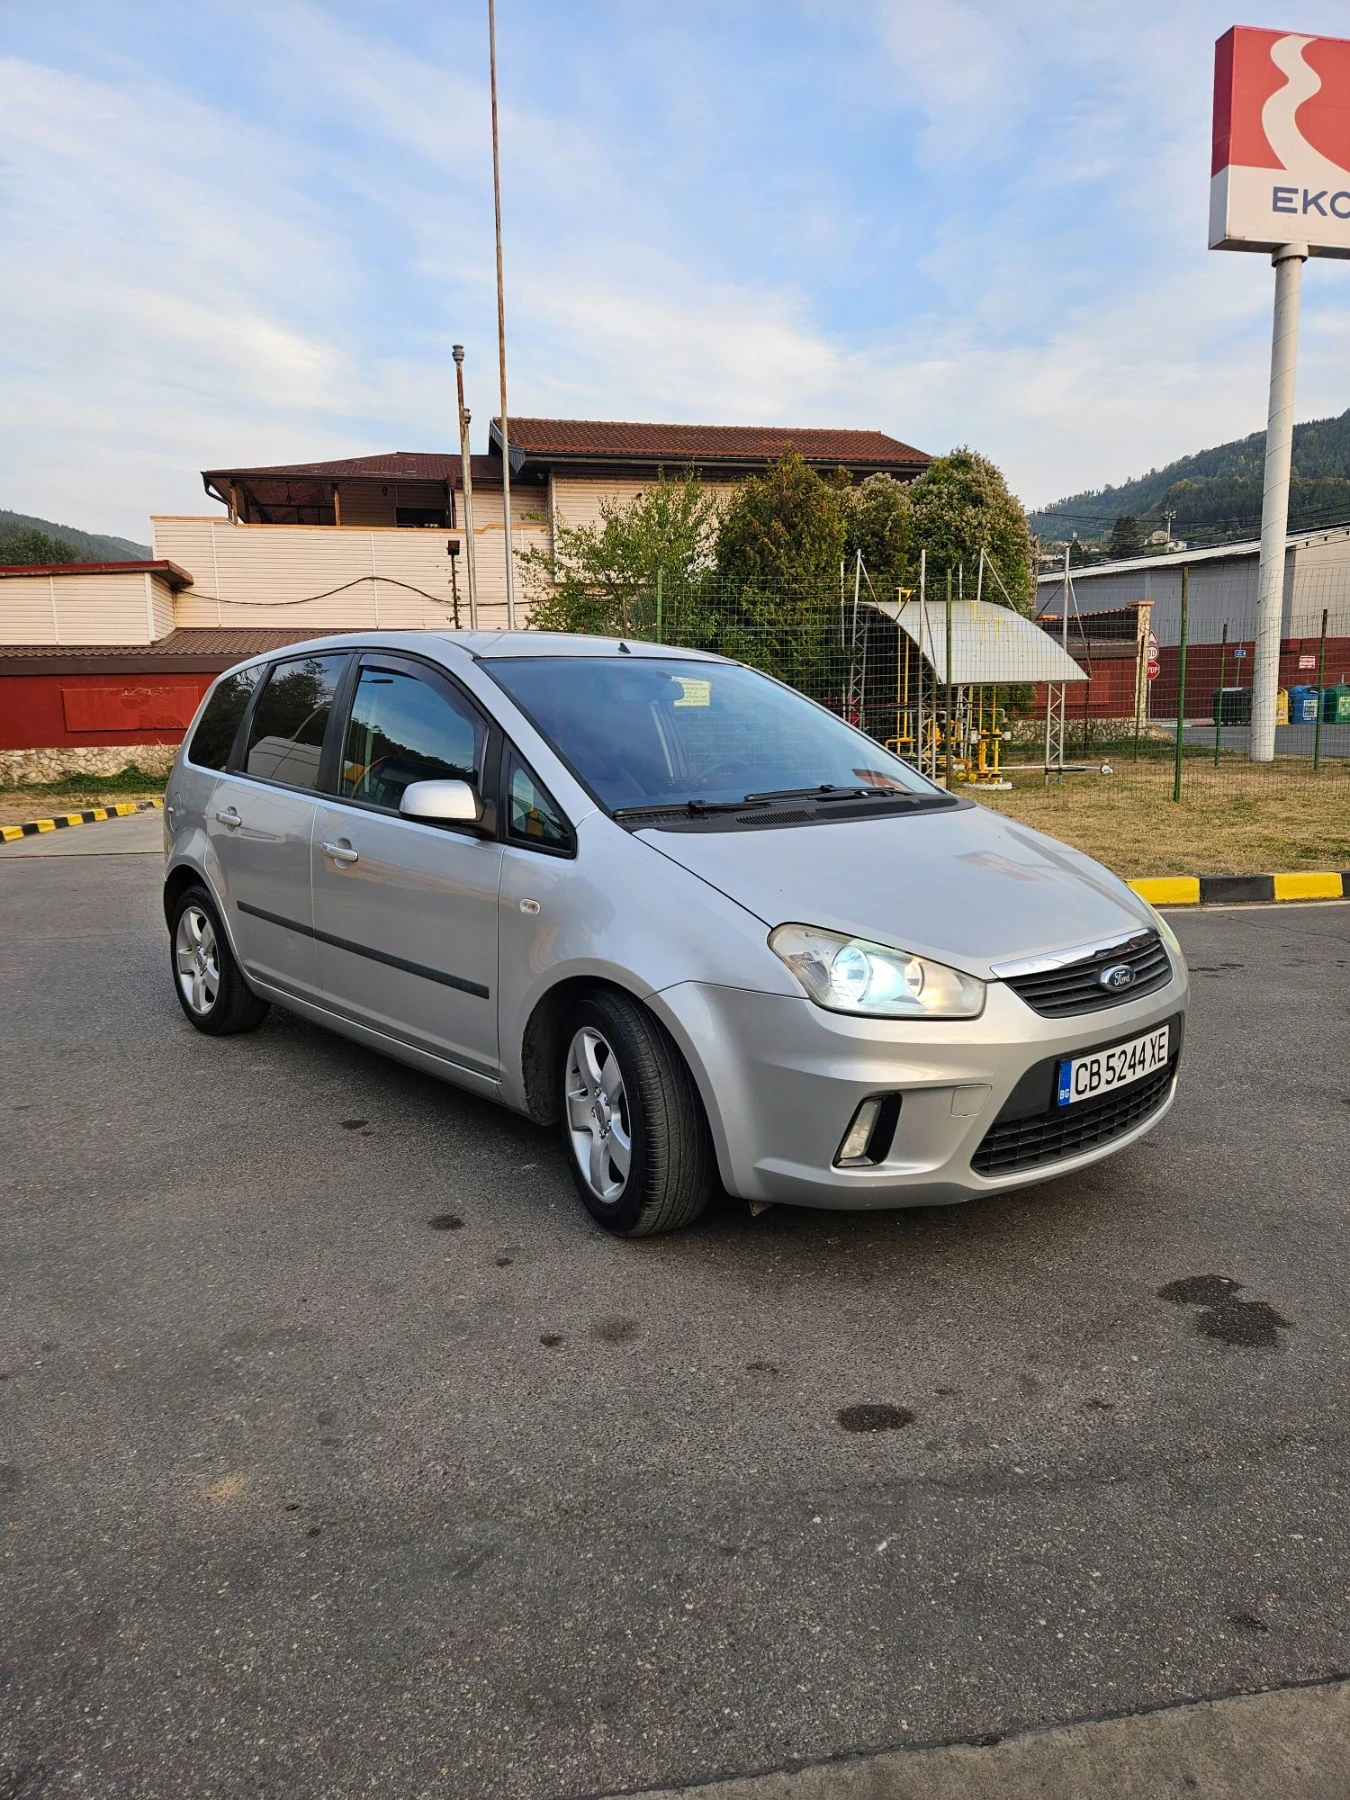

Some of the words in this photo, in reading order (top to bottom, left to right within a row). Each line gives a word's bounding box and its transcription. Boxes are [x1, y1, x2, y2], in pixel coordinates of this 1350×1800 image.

[1272, 186, 1350, 219] EKO
[1147, 649, 1156, 657] 30
[1147, 666, 1158, 674] TOP
[1114, 970, 1130, 986] Ford
[1075, 1059, 1102, 1095] CB
[1105, 1041, 1146, 1085] 5244
[1149, 1032, 1166, 1068] XE
[1060, 1089, 1070, 1100] BG
